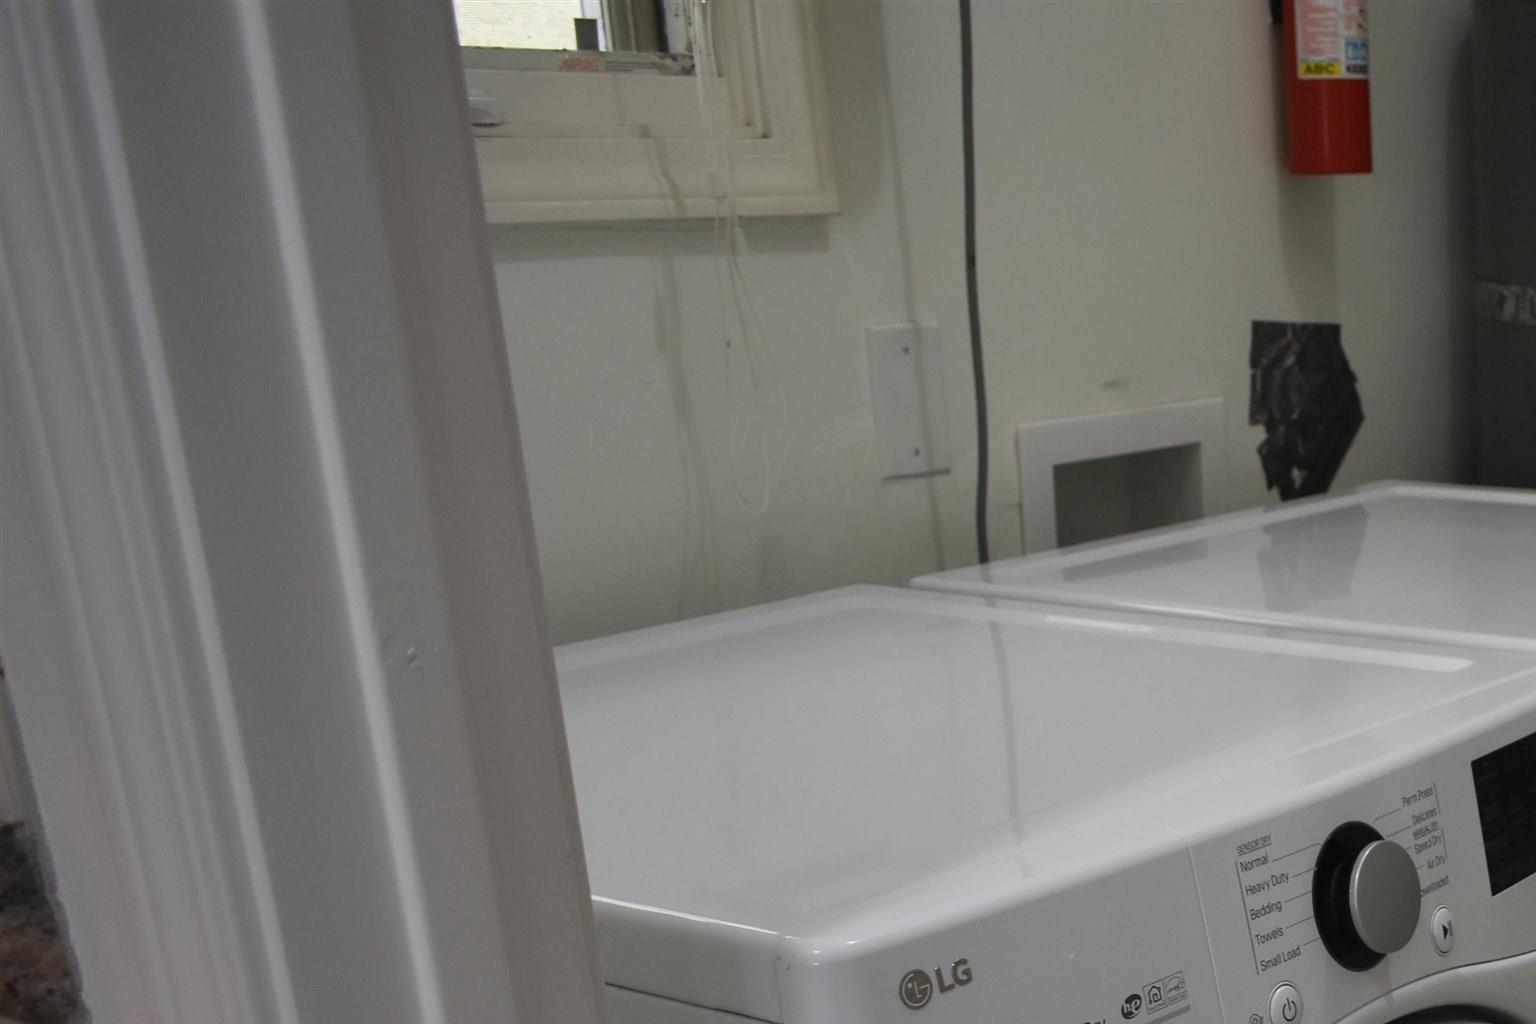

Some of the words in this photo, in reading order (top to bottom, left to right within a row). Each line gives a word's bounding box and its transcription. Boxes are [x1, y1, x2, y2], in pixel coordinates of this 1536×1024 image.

[1236, 838, 1260, 855] SENSOR
[1259, 834, 1272, 848] DRY
[1240, 853, 1270, 873] Normal
[1245, 877, 1271, 897] Heavy
[1271, 871, 1290, 887] Duty
[1249, 900, 1283, 921] Bedding
[1254, 926, 1284, 946] Towels
[1259, 953, 1282, 973] Small
[1281, 944, 1302, 963] Load
[934, 957, 974, 994] LG
